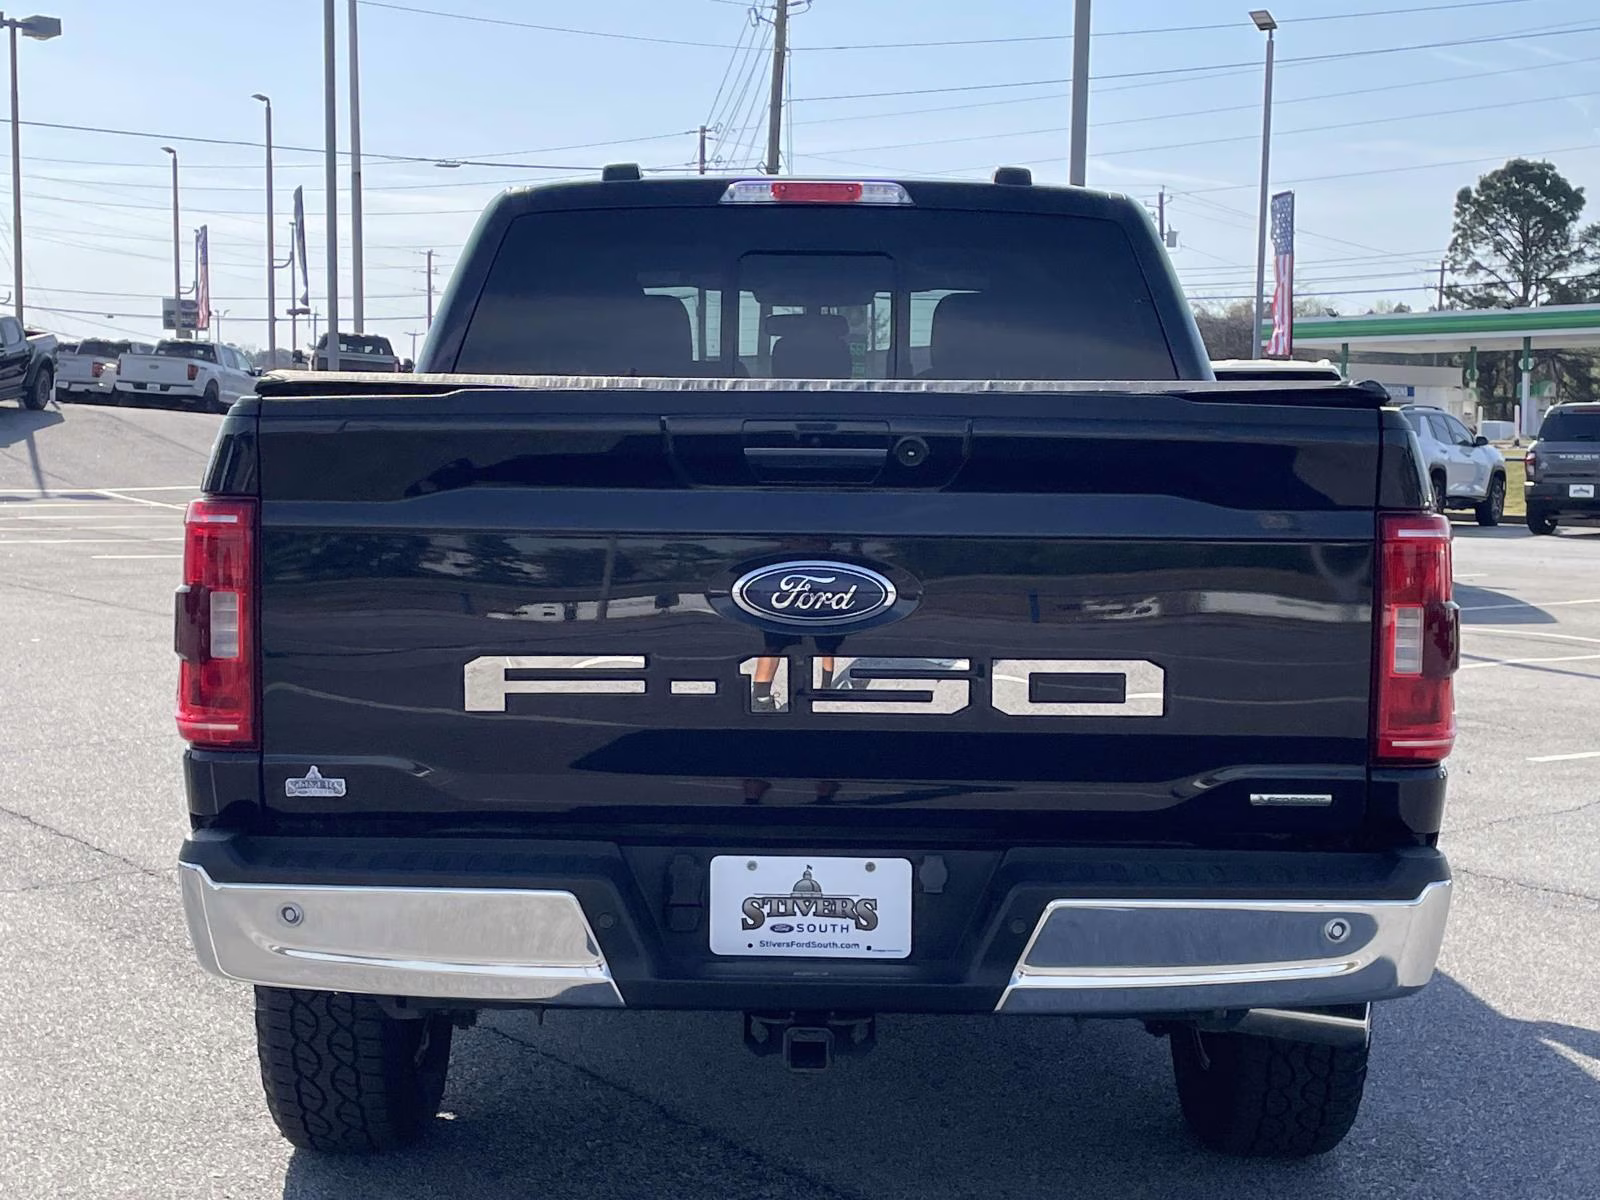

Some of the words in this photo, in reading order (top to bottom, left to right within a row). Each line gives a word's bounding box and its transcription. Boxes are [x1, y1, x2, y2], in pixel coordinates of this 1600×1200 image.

[771, 574, 858, 610] Ford
[464, 655, 1165, 717] F-150
[741, 896, 879, 932] STIVERS
[796, 923, 850, 933] SOUTH
[759, 940, 861, 949] StiversFordSouth.com
